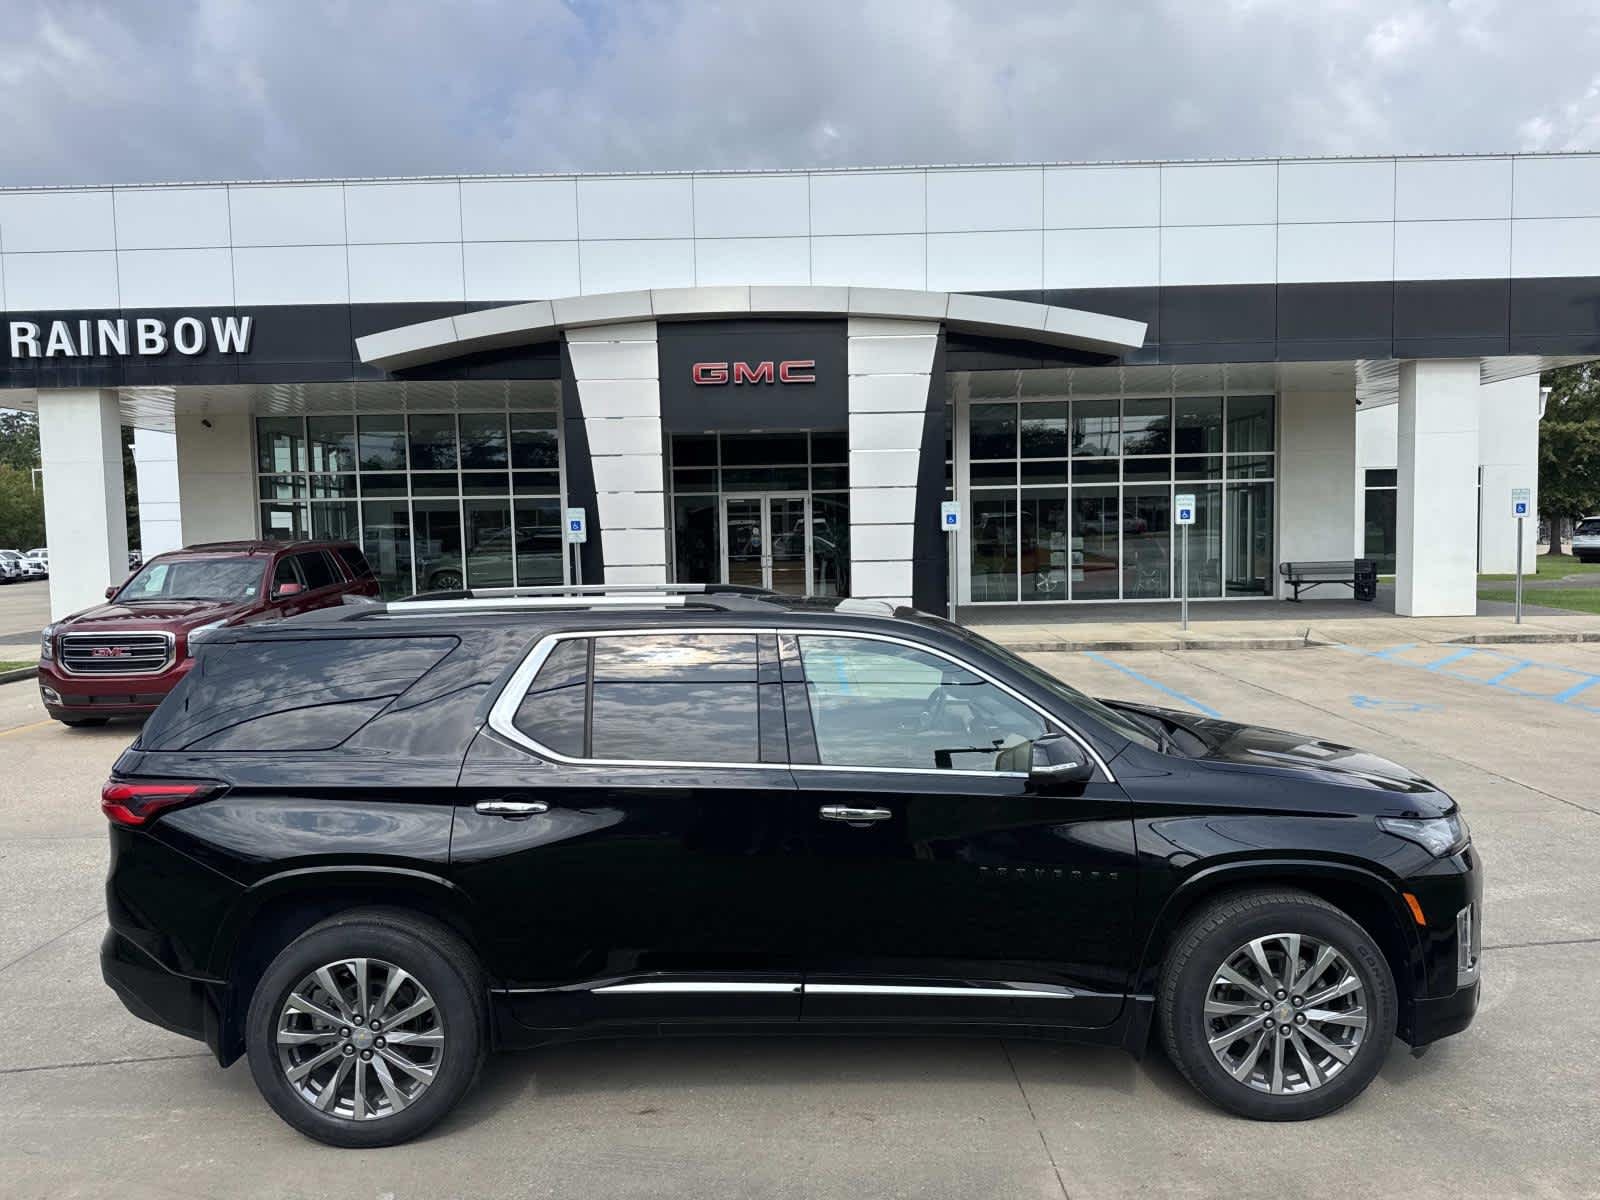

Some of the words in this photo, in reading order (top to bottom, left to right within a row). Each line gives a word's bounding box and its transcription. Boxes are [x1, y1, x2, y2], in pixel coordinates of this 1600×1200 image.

[9, 316, 252, 358] RAINBOW
[692, 360, 816, 385] GMC
[91, 646, 132, 657] GMC
